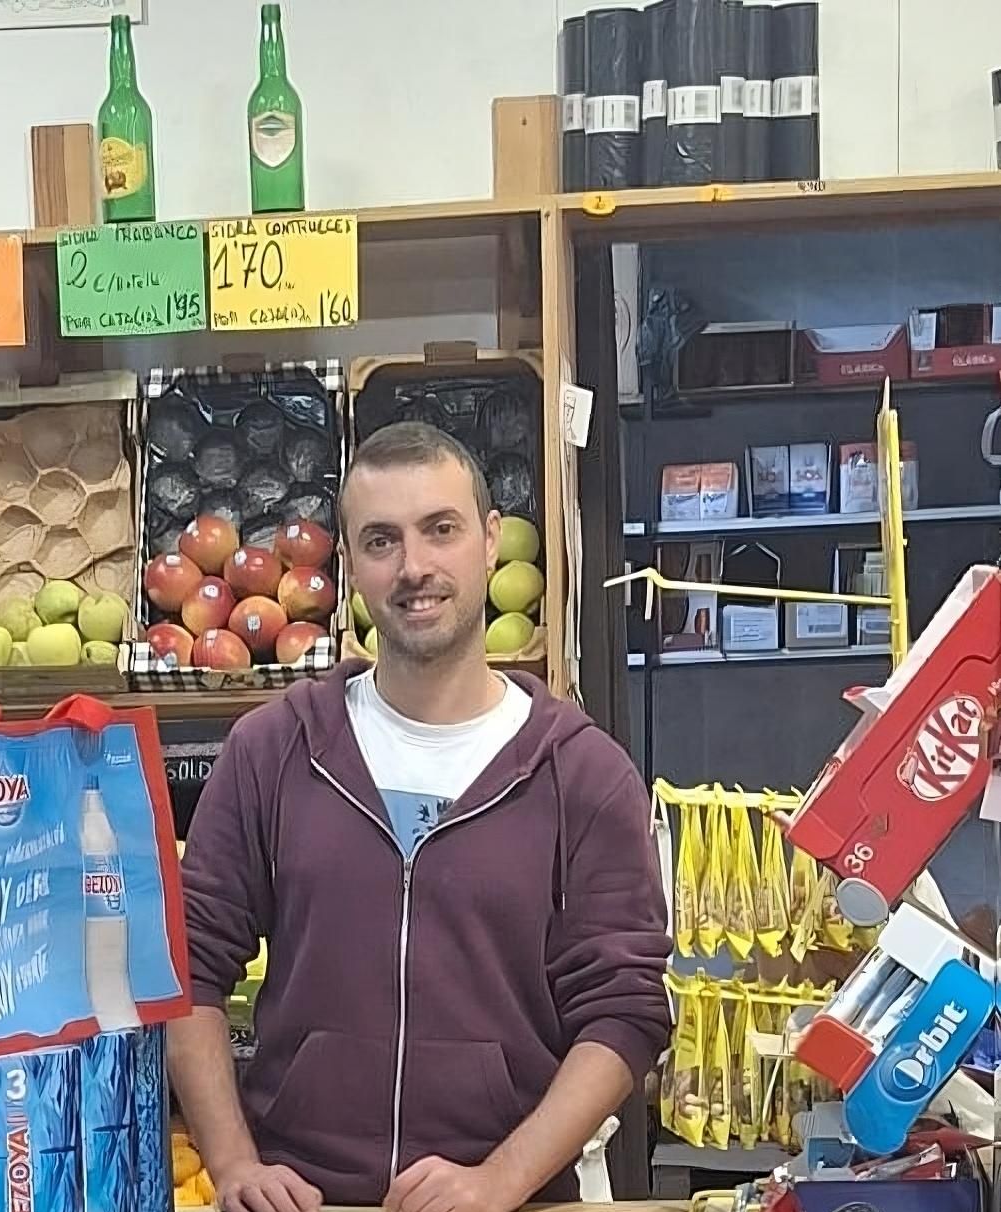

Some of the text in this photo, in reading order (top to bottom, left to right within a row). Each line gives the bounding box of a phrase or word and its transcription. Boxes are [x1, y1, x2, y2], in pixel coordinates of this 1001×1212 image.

[844, 841, 875, 875] 36
[891, 999, 970, 1089] Orbit
[6, 1069, 27, 1100] 3
